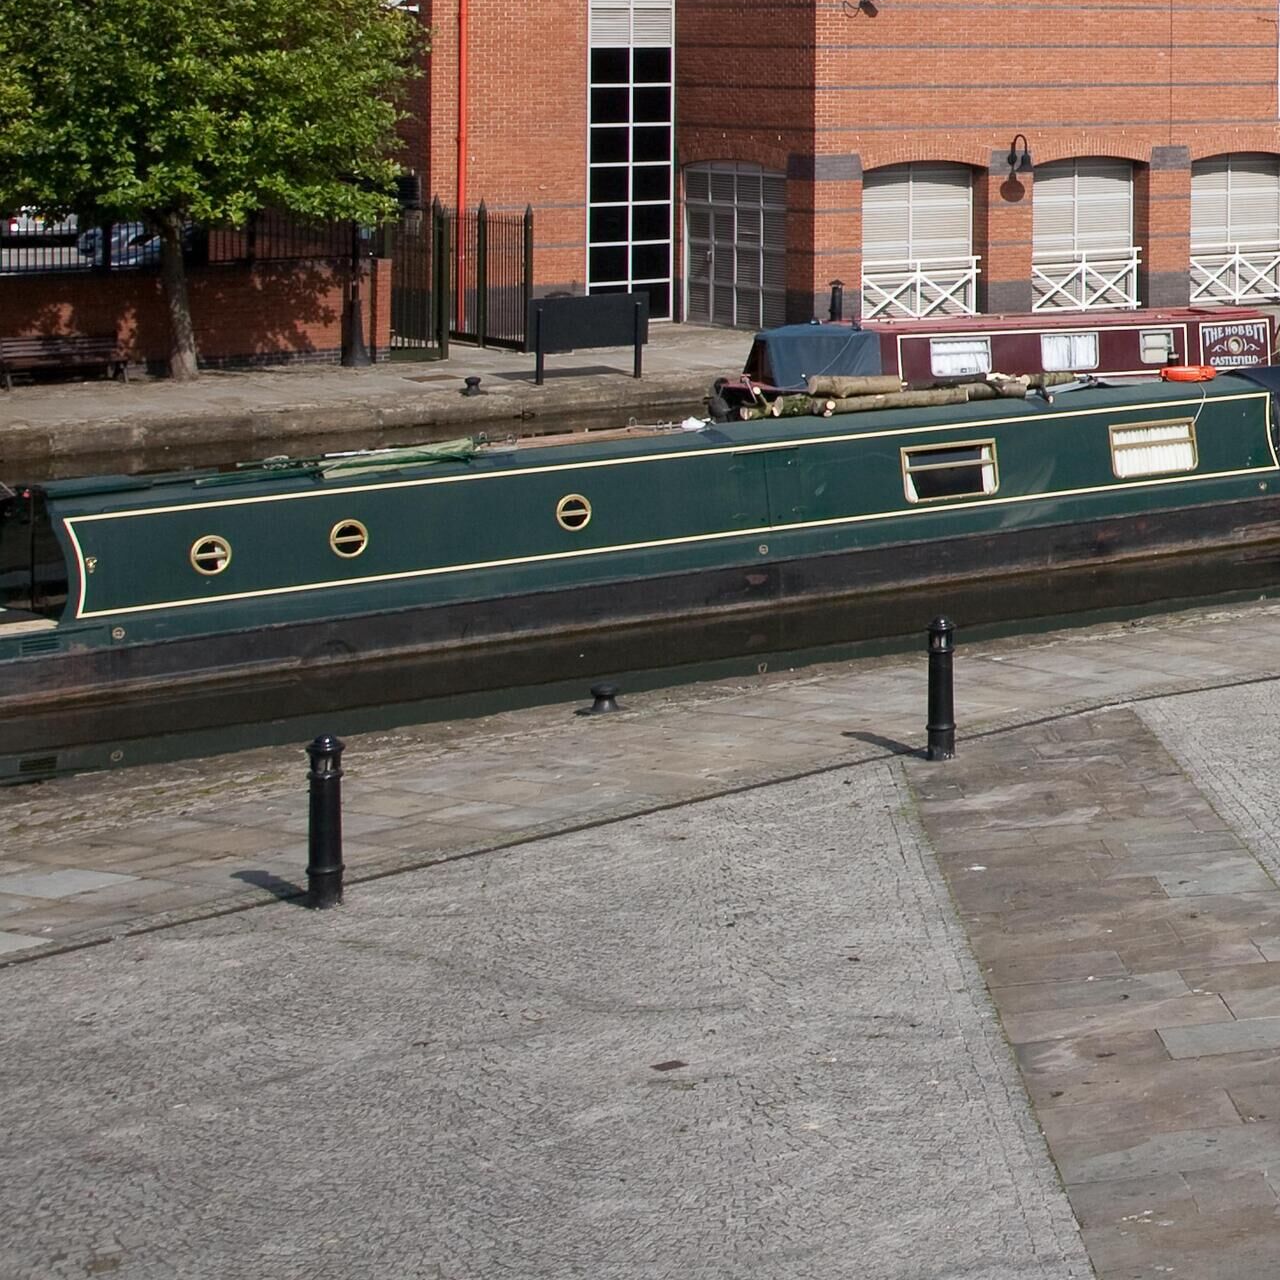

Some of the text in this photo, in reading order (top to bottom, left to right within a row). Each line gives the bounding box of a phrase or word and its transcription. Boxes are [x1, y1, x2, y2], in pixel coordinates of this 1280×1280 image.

[1203, 323, 1266, 347] THE HOBBIT
[1210, 355, 1259, 365] CASTLEFIELD
